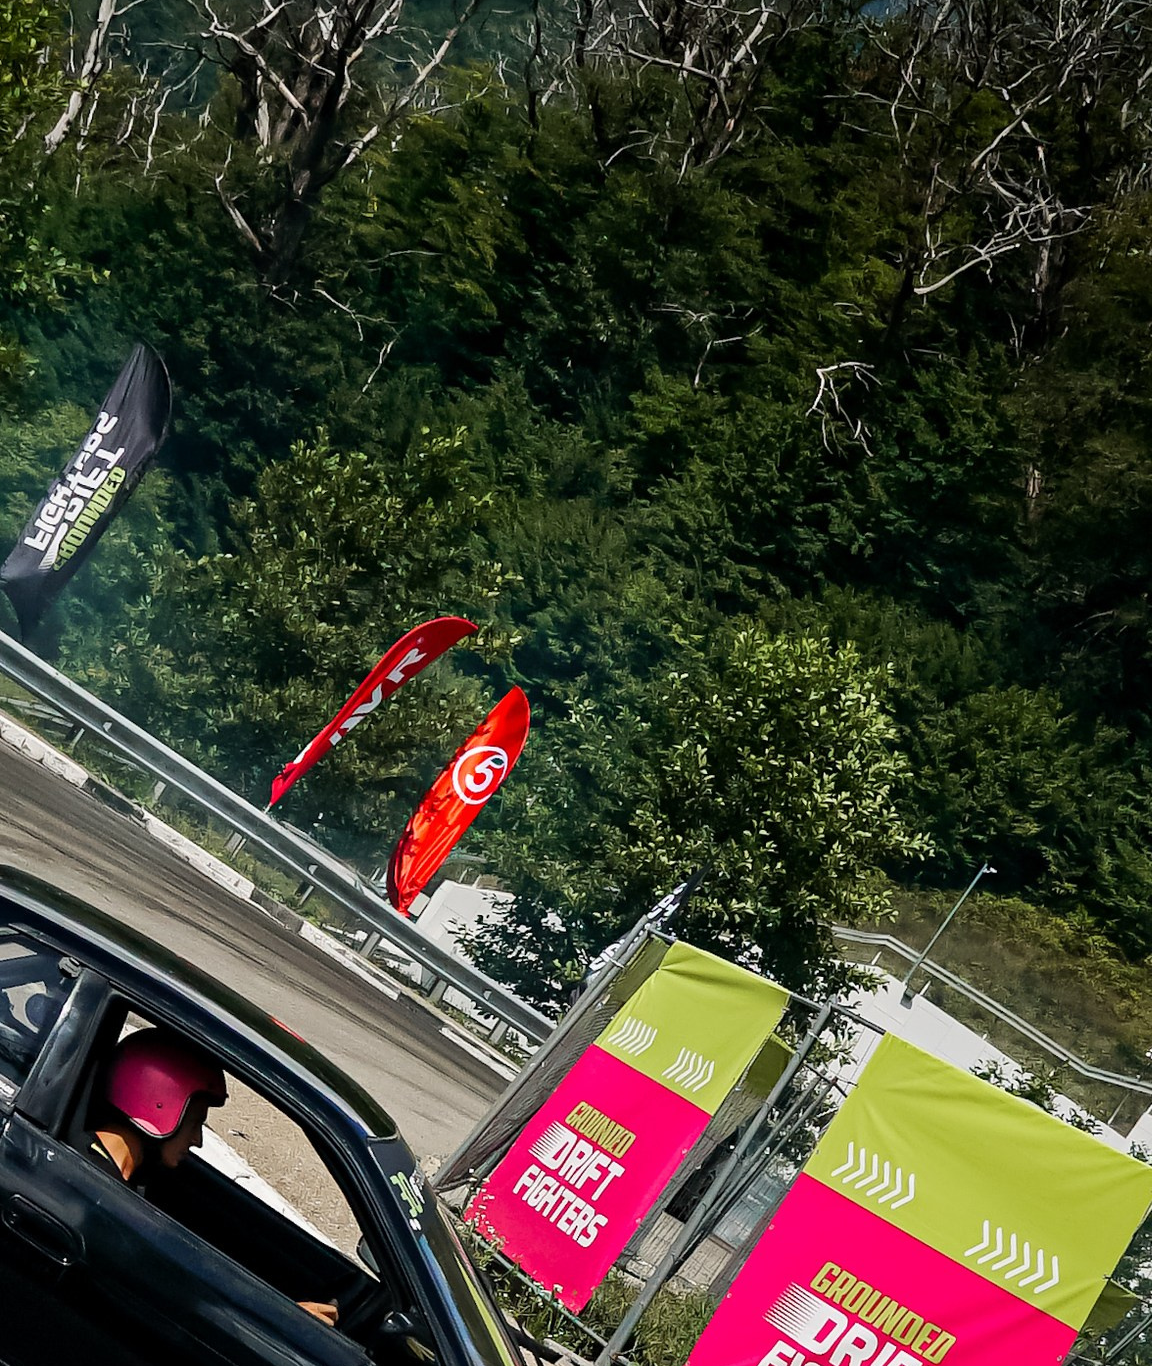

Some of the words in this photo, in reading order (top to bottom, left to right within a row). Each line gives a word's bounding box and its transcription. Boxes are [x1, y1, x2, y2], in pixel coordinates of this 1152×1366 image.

[532, 1123, 625, 1201] DRIFT
[513, 1164, 608, 1248] FIGHTERS
[810, 1261, 957, 1365] GROUNDED
